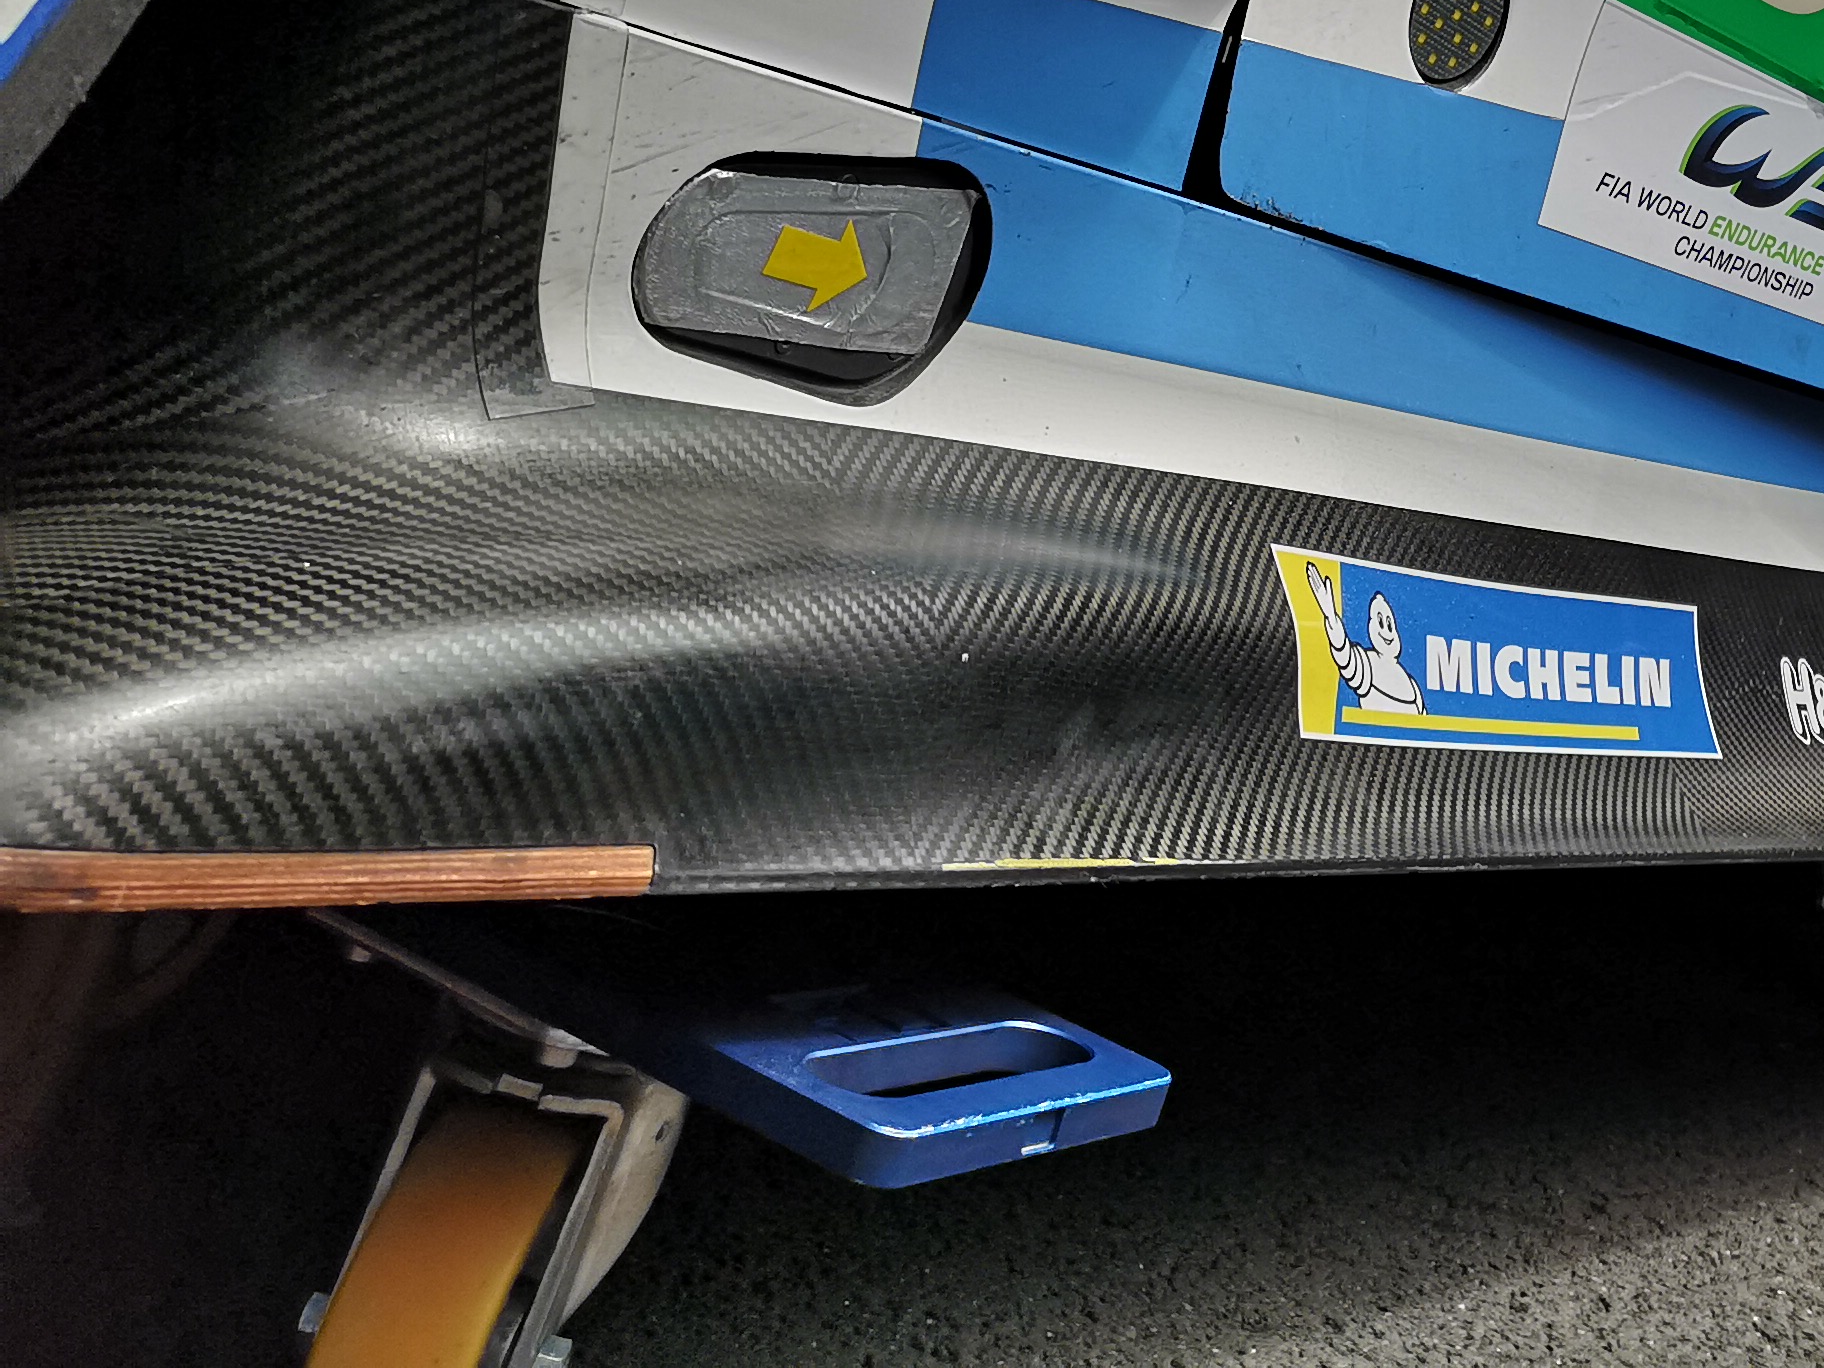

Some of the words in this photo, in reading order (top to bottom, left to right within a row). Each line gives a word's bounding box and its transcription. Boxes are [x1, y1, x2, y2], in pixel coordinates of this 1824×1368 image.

[1595, 172, 1632, 205] FIA
[1636, 185, 1709, 231] WORLD
[1673, 234, 1815, 303] CHAMPIONSHIP
[1425, 633, 1674, 709] MICHELIN
